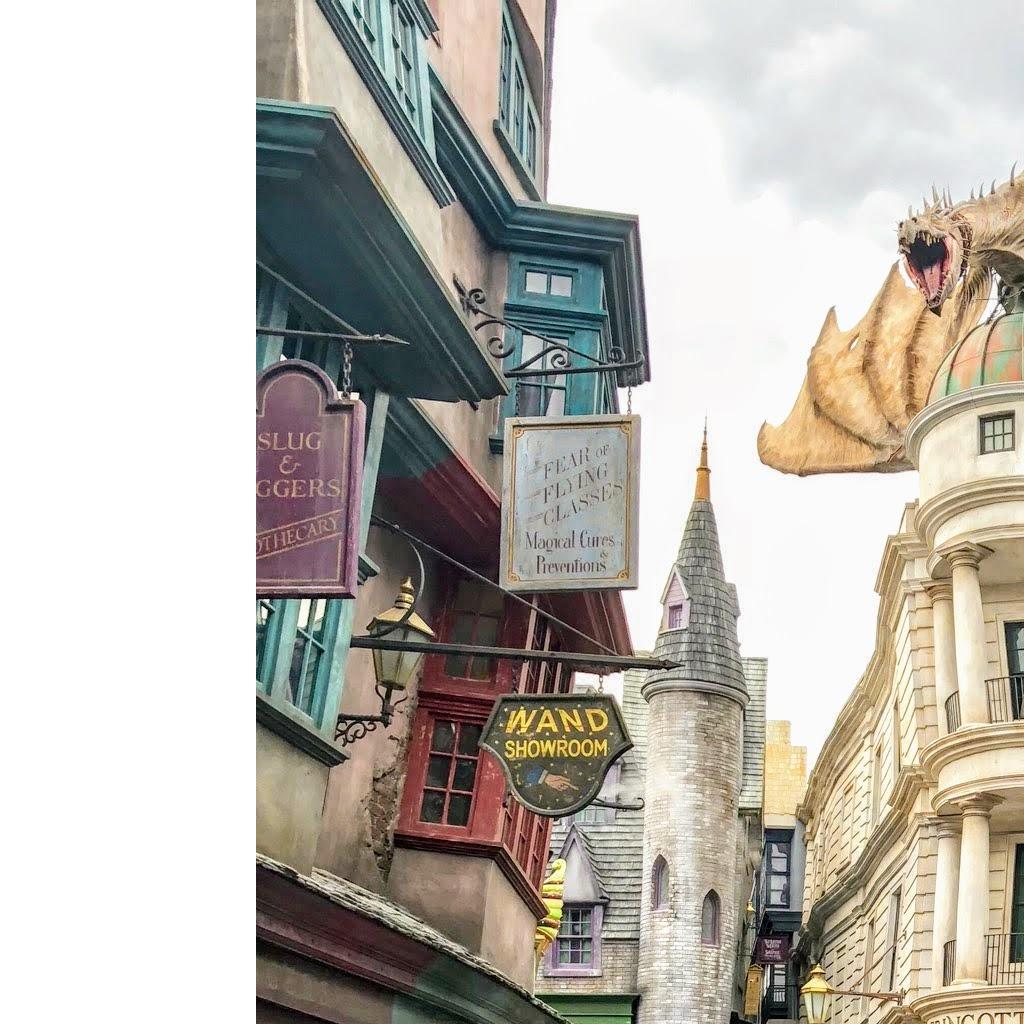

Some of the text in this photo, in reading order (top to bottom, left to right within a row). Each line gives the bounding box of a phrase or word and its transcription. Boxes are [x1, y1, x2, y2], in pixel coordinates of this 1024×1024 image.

[257, 432, 321, 450] SLUG
[279, 455, 301, 474] &
[544, 444, 610, 480] FEAR OF
[256, 479, 341, 497] GGERS
[543, 462, 608, 504] FLYING
[525, 529, 615, 552] Magical Cures
[536, 554, 607, 575] Preventions
[505, 708, 609, 733] WAND
[504, 739, 608, 758] SHOWROOM
